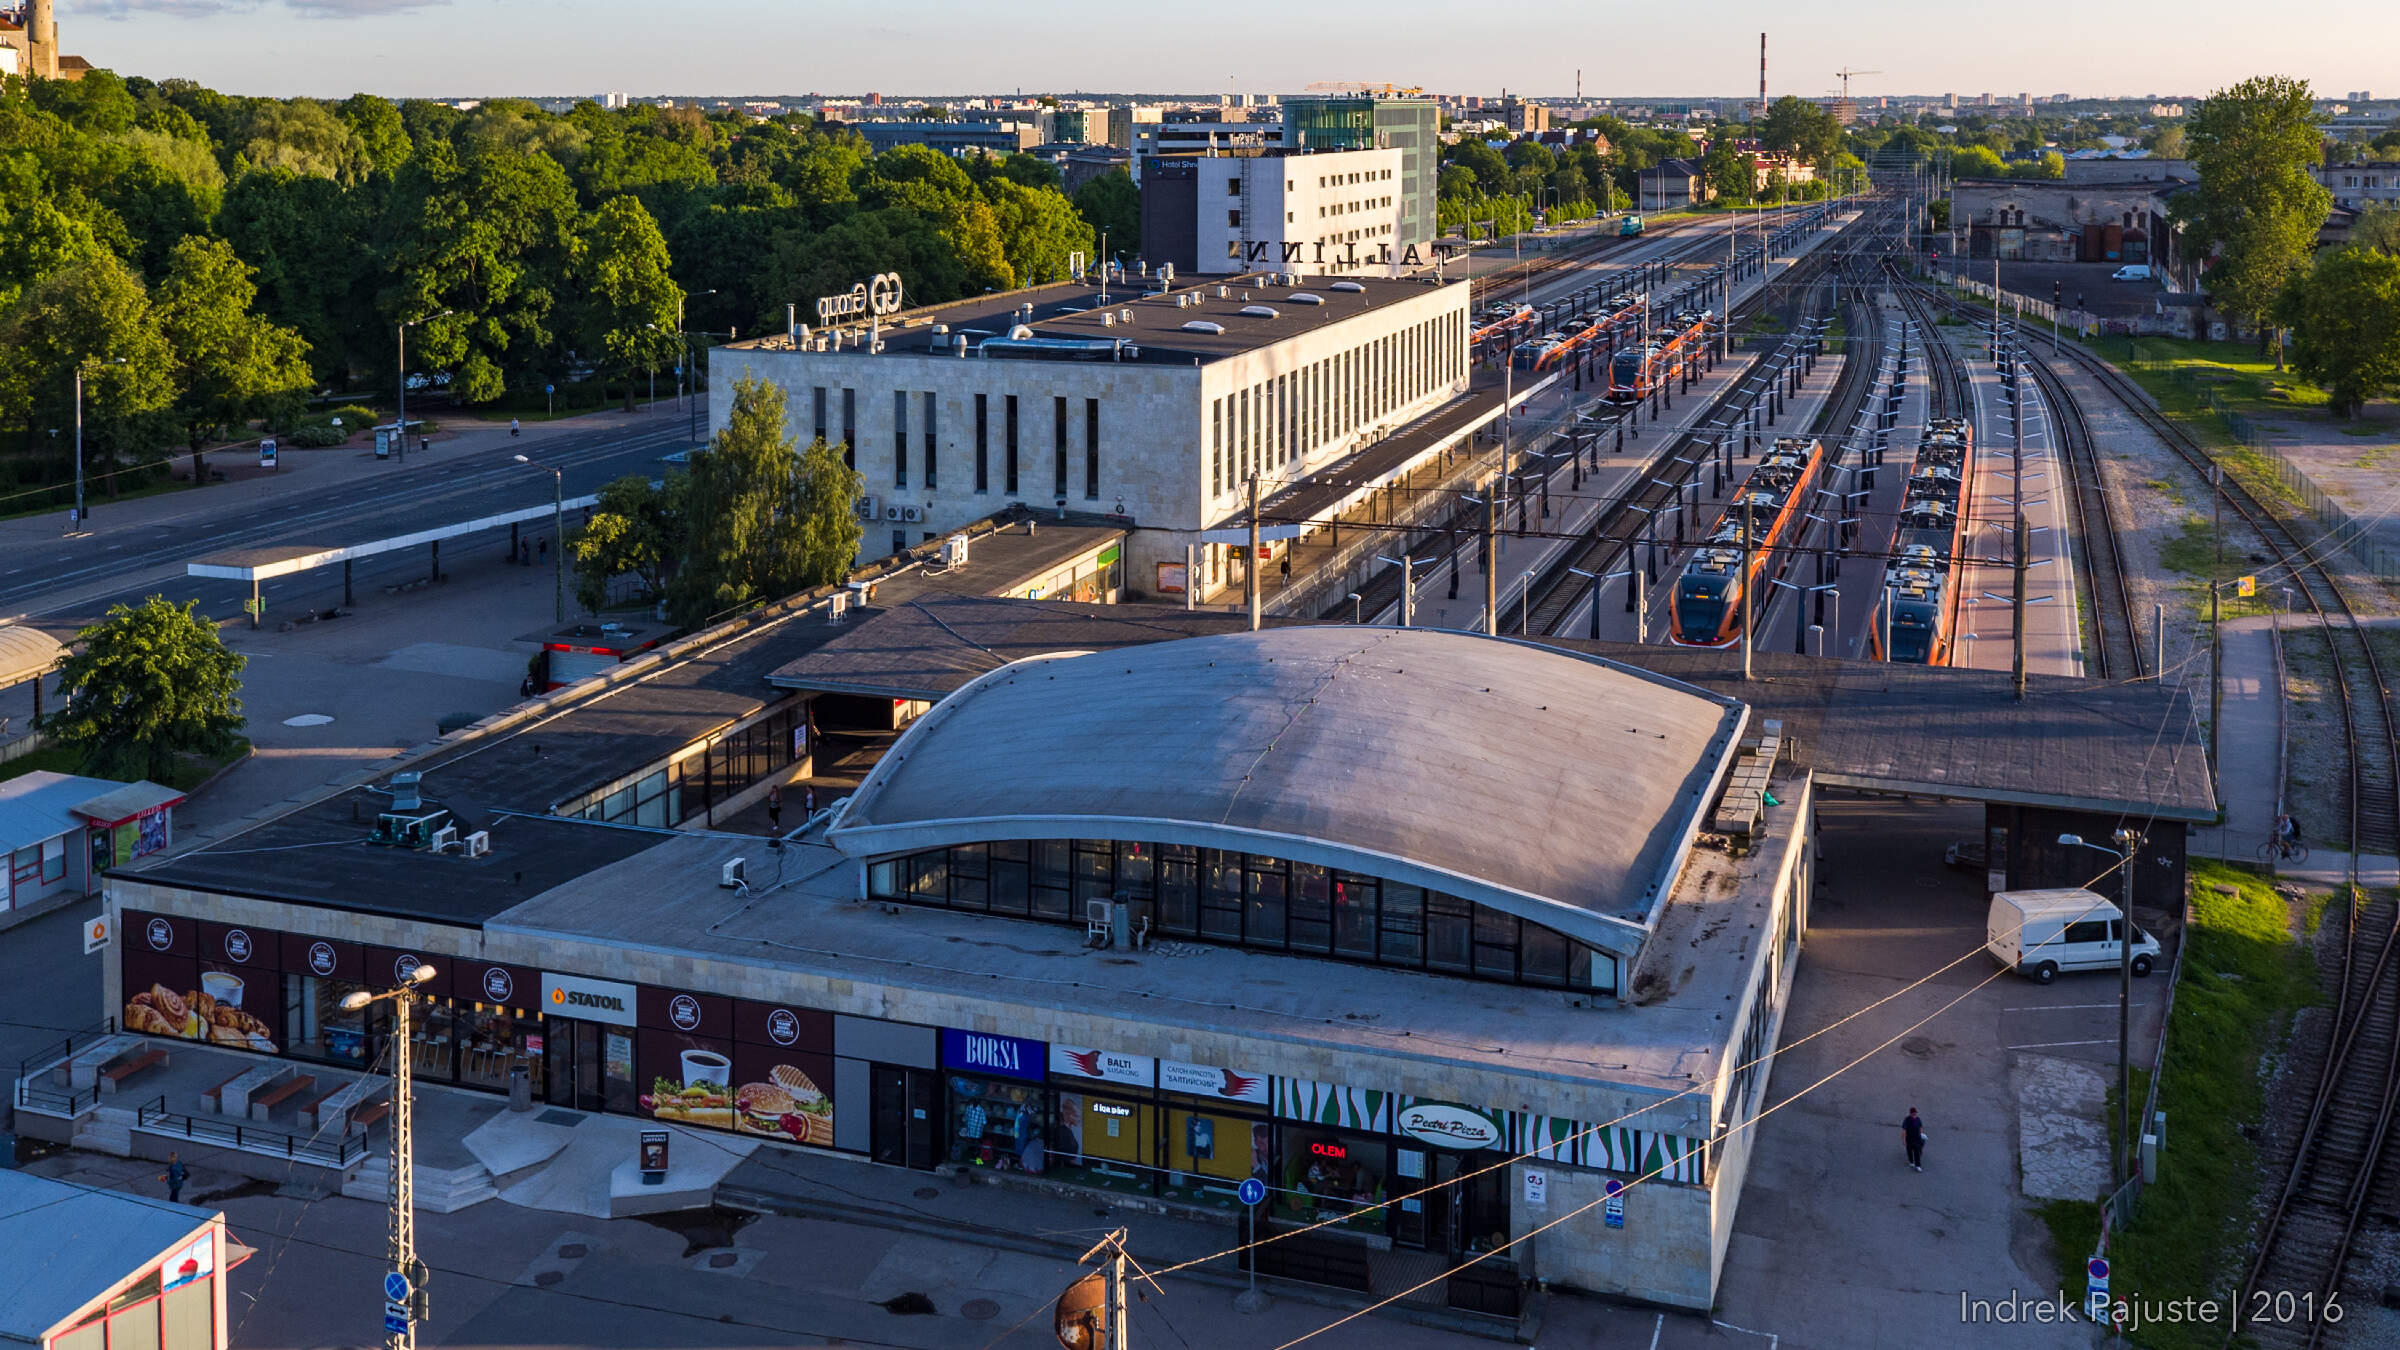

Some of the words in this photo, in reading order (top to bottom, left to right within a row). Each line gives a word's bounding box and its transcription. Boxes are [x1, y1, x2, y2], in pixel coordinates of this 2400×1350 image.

[1162, 159, 1180, 168] Hotel
[568, 991, 624, 1011] STATOIL
[966, 1034, 1020, 1071] BORSA
[1107, 1058, 1132, 1069] BALTI
[1411, 1114, 1449, 1130] Peetri
[1450, 1121, 1486, 1137] Pizza
[1311, 1142, 1346, 1159] OLEM
